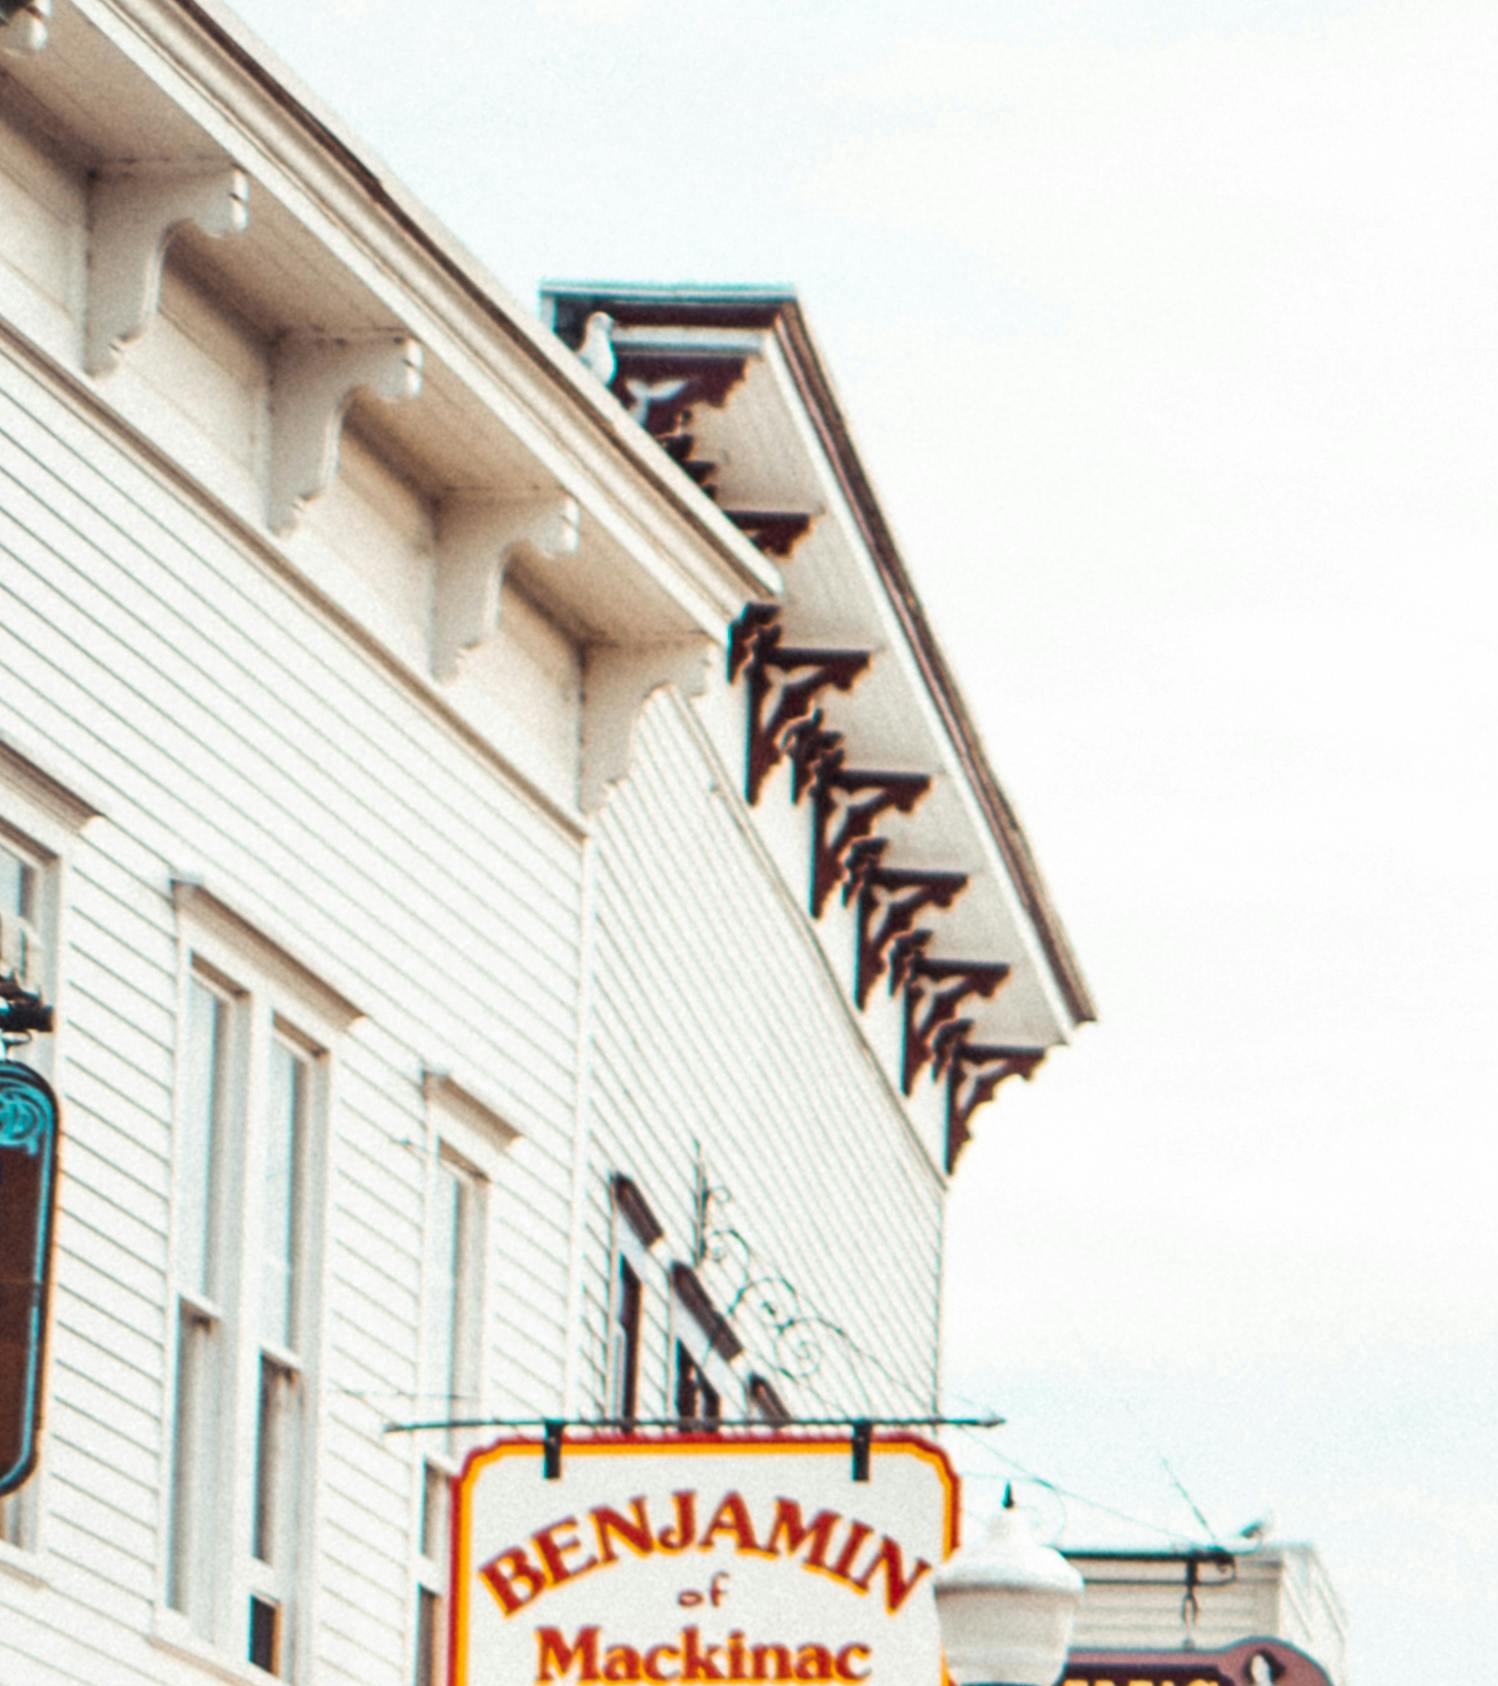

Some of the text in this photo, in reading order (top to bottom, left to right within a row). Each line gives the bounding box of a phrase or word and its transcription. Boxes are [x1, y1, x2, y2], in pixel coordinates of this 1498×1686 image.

[479, 1490, 932, 1618] BENJAMIN
[678, 1571, 730, 1609] of
[534, 1625, 873, 1686] Mackinac
